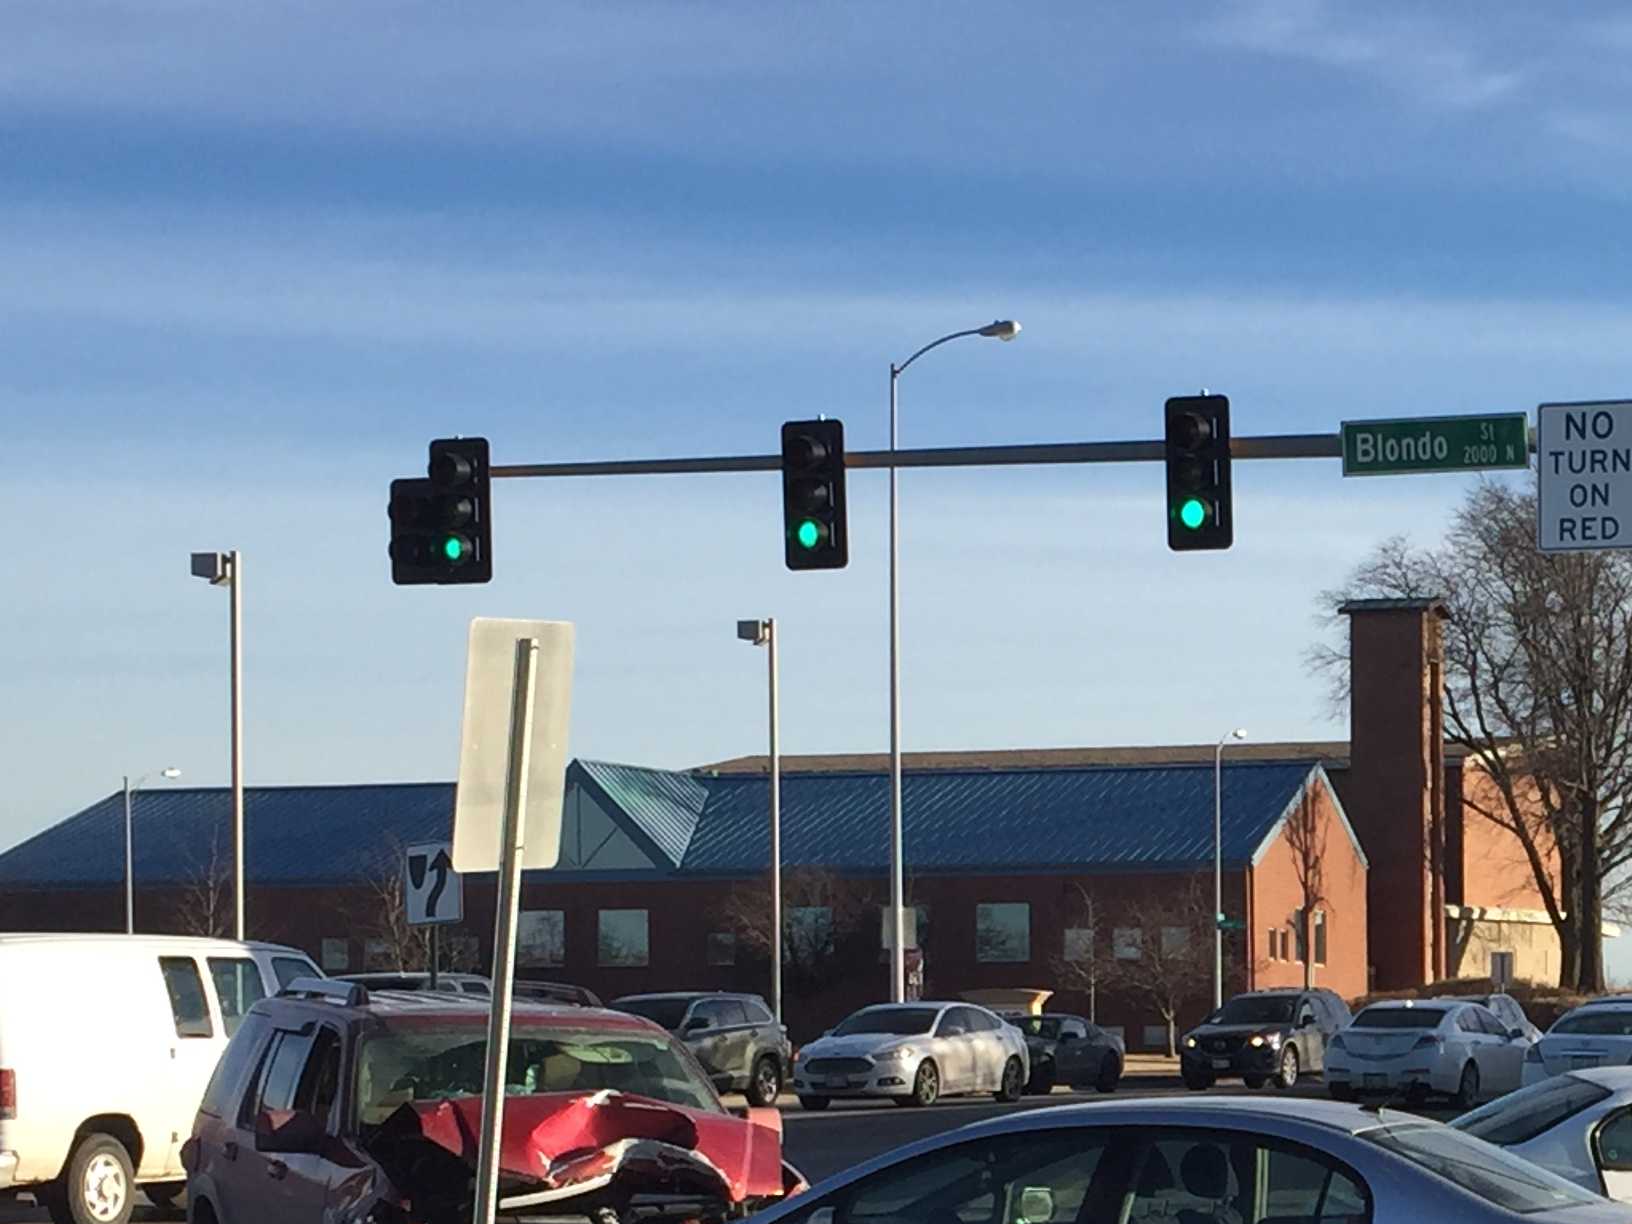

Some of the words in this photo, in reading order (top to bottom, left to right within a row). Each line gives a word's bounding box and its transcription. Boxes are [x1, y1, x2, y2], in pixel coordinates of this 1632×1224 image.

[1565, 411, 1613, 440] NO
[1356, 431, 1448, 462] Blondo
[1464, 445, 1497, 464] 2000
[1506, 444, 1515, 461] N
[1549, 449, 1631, 475] TURN
[1569, 483, 1609, 508] ON
[1559, 517, 1620, 541] RED
